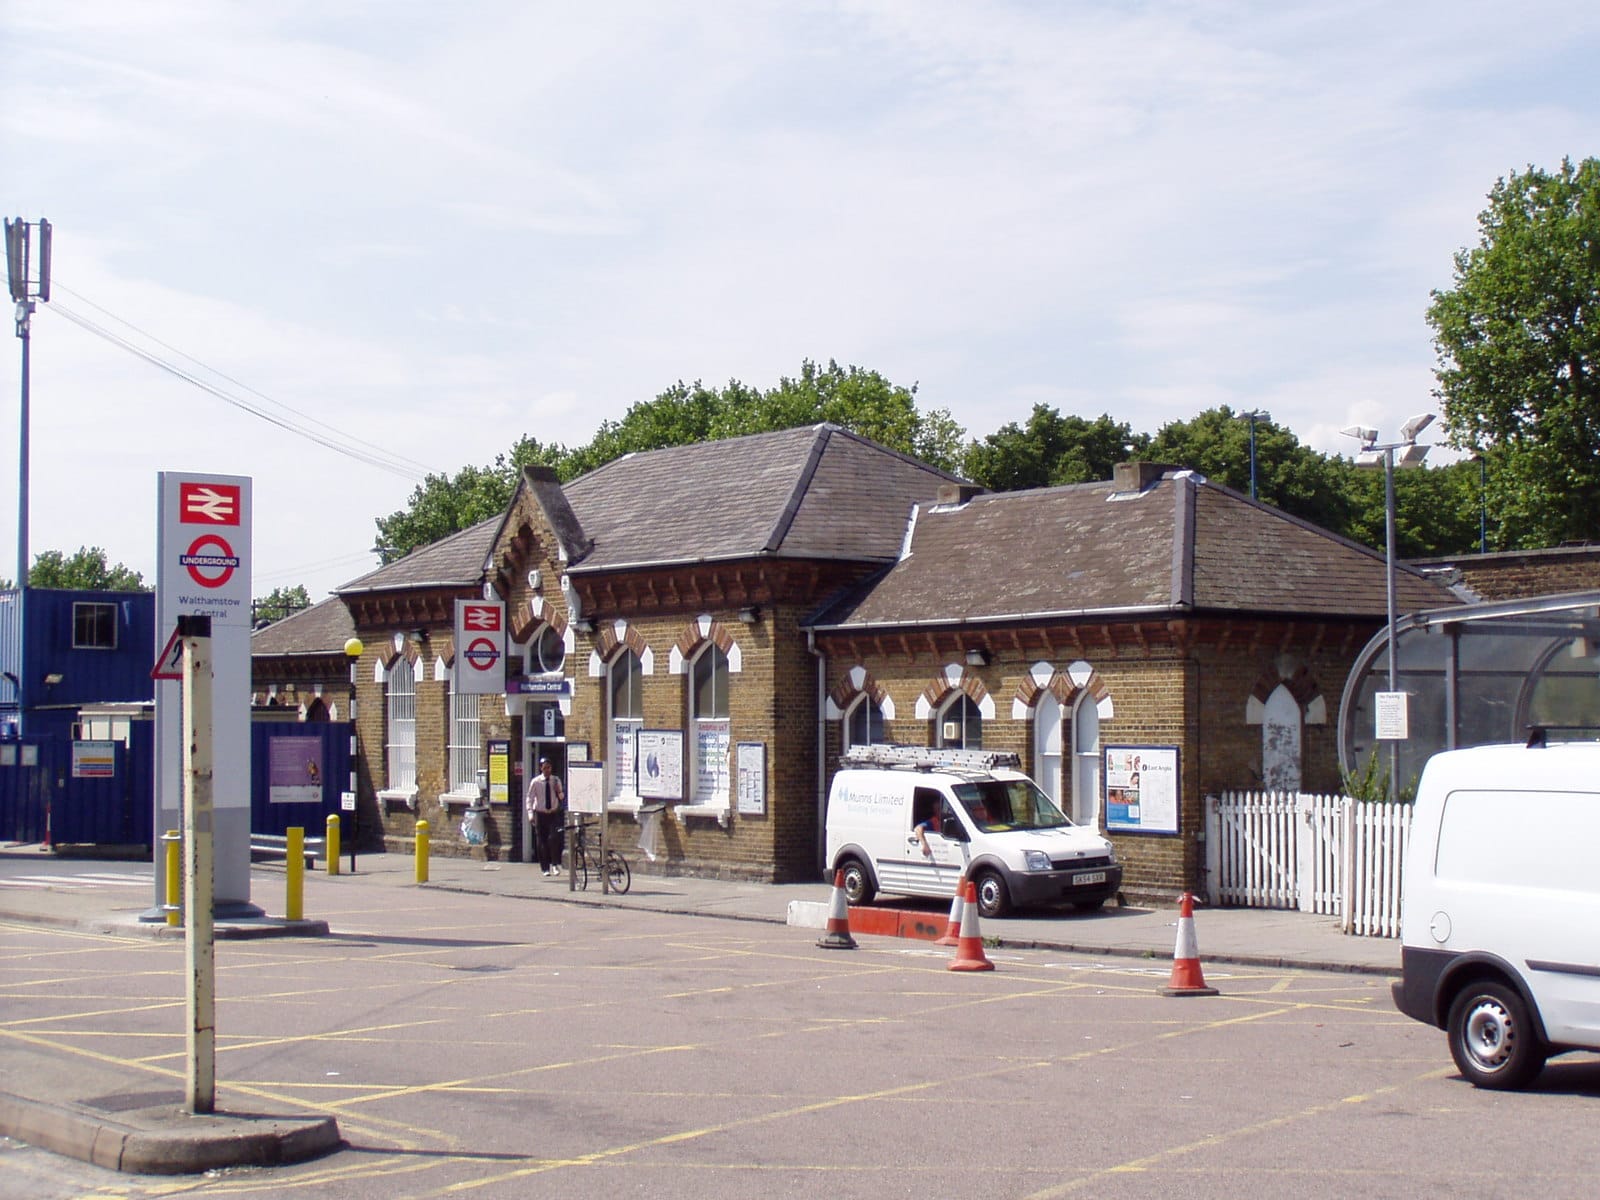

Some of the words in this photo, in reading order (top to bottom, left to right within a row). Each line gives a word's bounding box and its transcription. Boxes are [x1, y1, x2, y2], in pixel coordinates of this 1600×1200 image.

[182, 557, 237, 566] UNDERGROUND
[179, 596, 240, 606] Walthamstow
[193, 609, 227, 618] Central
[616, 723, 631, 733] Enrol
[616, 735, 632, 745] Now!
[849, 792, 872, 804] Munns
[874, 793, 904, 806] Limited
